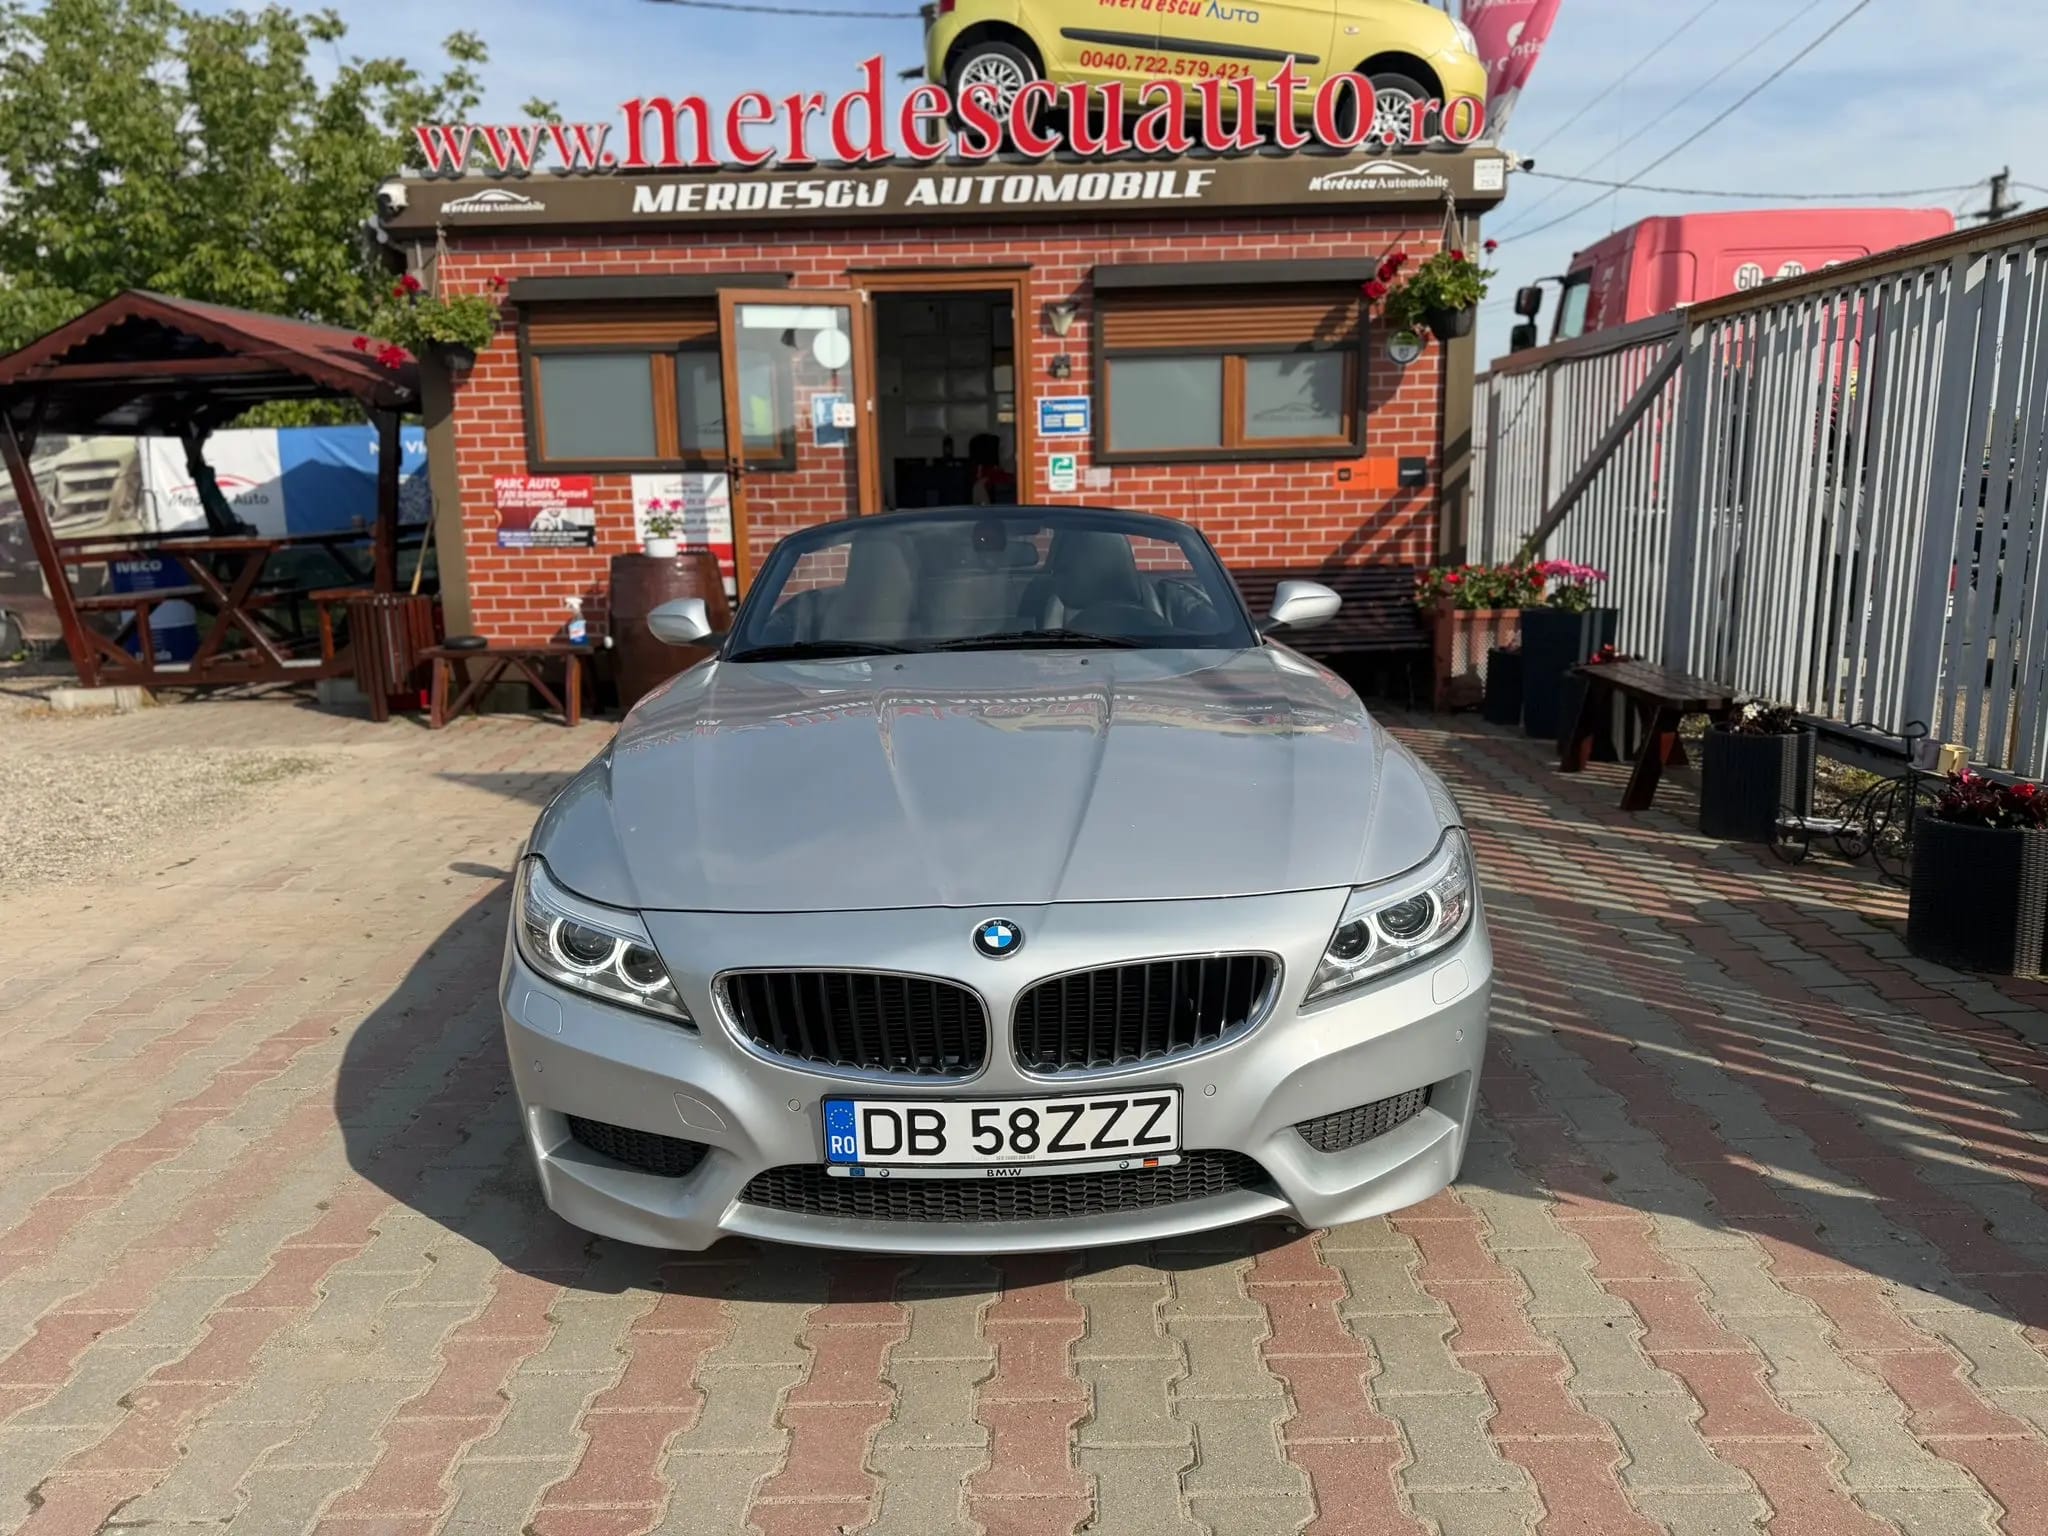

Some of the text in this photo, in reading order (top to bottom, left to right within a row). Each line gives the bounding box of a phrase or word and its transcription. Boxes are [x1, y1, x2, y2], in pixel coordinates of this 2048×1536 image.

[1079, 50, 1251, 80] 0040.722.579.421
[413, 54, 1486, 173] www.merdescuauto.ro
[632, 169, 1216, 213] MERDESCU AUTOMOBILE
[1738, 266, 1759, 289] 60
[495, 477, 561, 490] PARC AUTO
[116, 561, 163, 574] IVECO
[831, 1135, 855, 1154] RO
[863, 1107, 947, 1157] DB
[986, 1168, 1022, 1177] BMW
